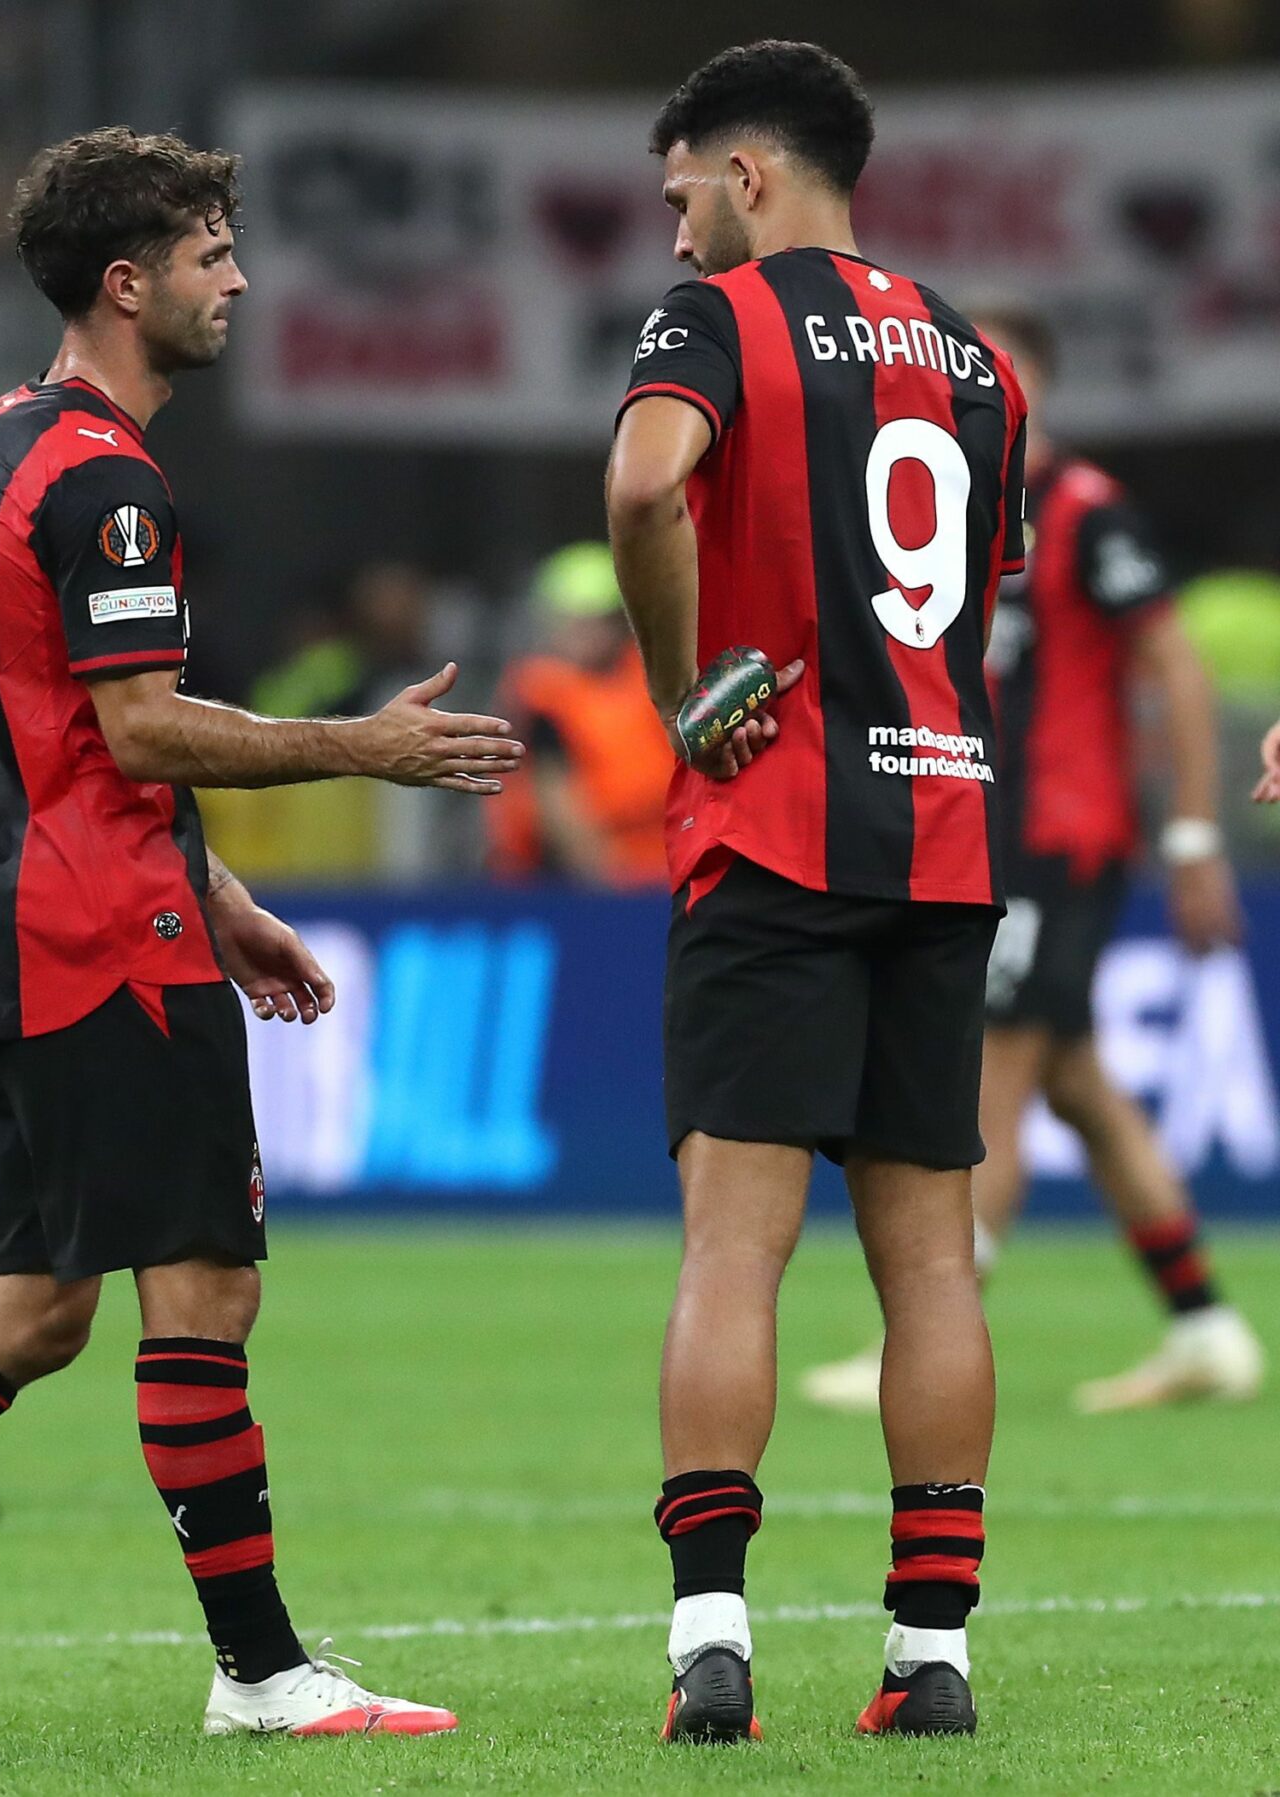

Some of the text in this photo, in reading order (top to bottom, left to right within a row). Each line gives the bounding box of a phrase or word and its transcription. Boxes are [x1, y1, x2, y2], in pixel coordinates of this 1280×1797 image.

[633, 327, 689, 364] SC
[804, 314, 996, 388] G.RAMOS
[864, 417, 972, 650] 9
[91, 595, 174, 614] FOUNDATION
[868, 725, 985, 759] madhappy
[868, 751, 995, 783] foundation
